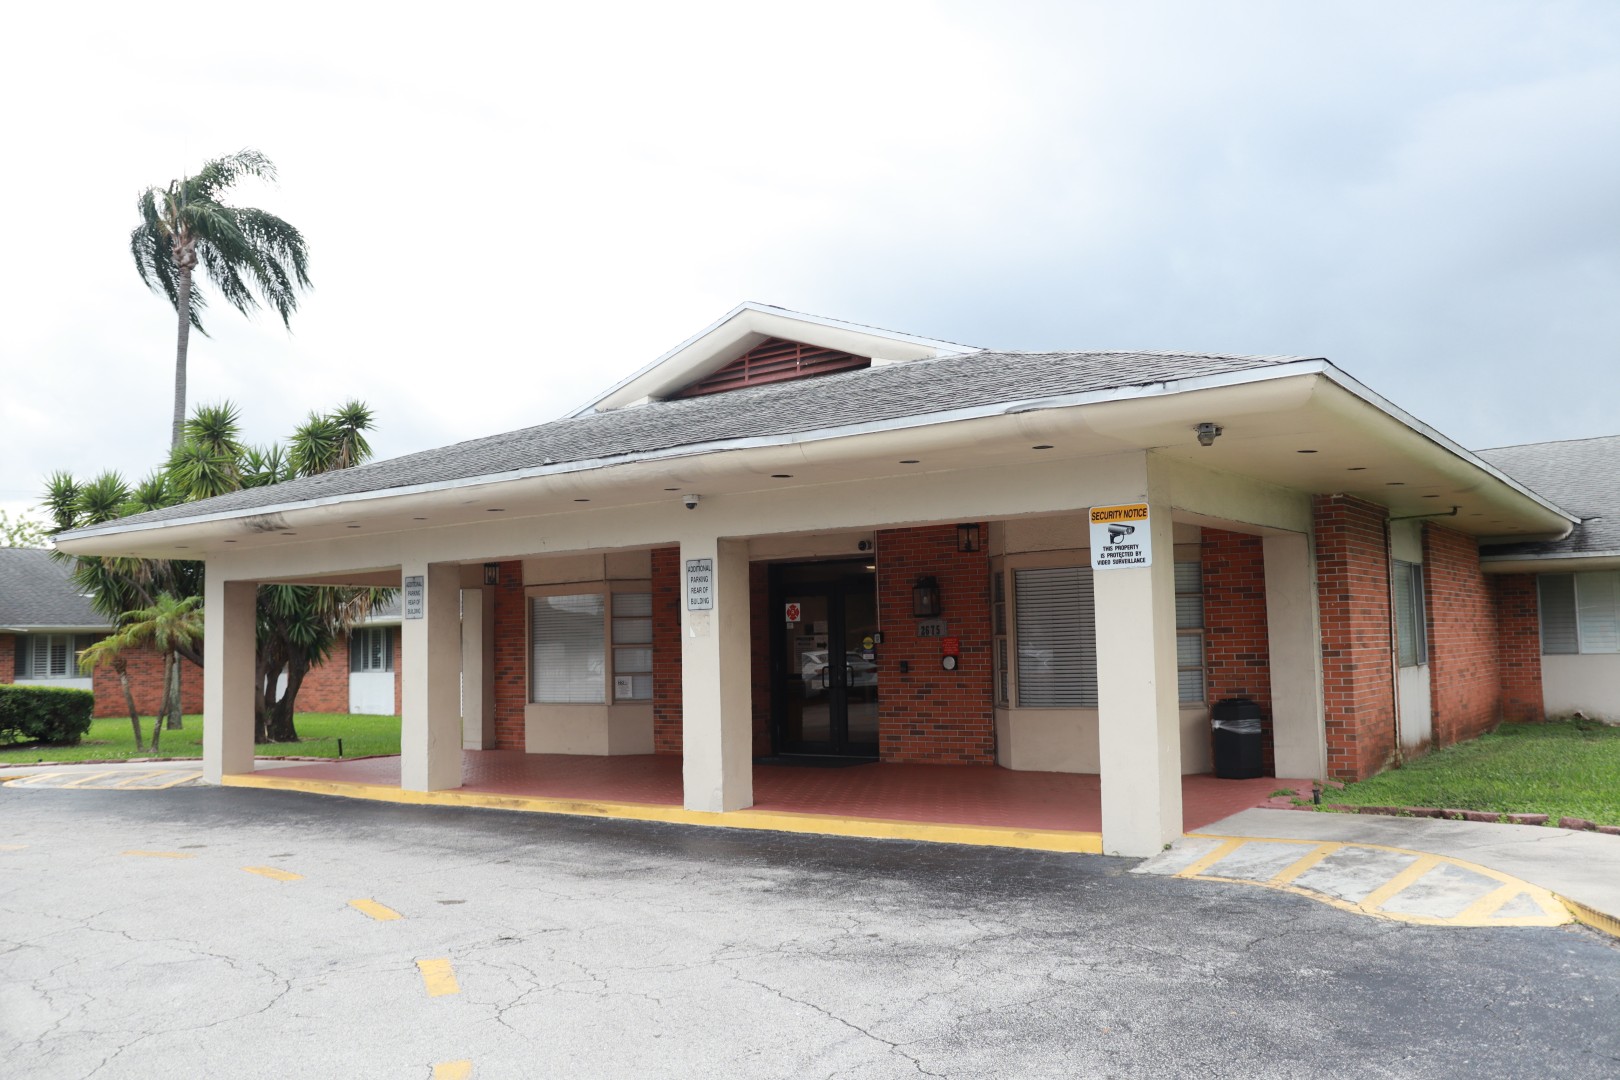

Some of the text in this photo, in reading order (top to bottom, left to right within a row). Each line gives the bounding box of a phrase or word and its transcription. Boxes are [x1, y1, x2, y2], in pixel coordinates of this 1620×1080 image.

[1092, 508, 1148, 520] SECURITY NOTICE
[921, 625, 940, 635] 2675
